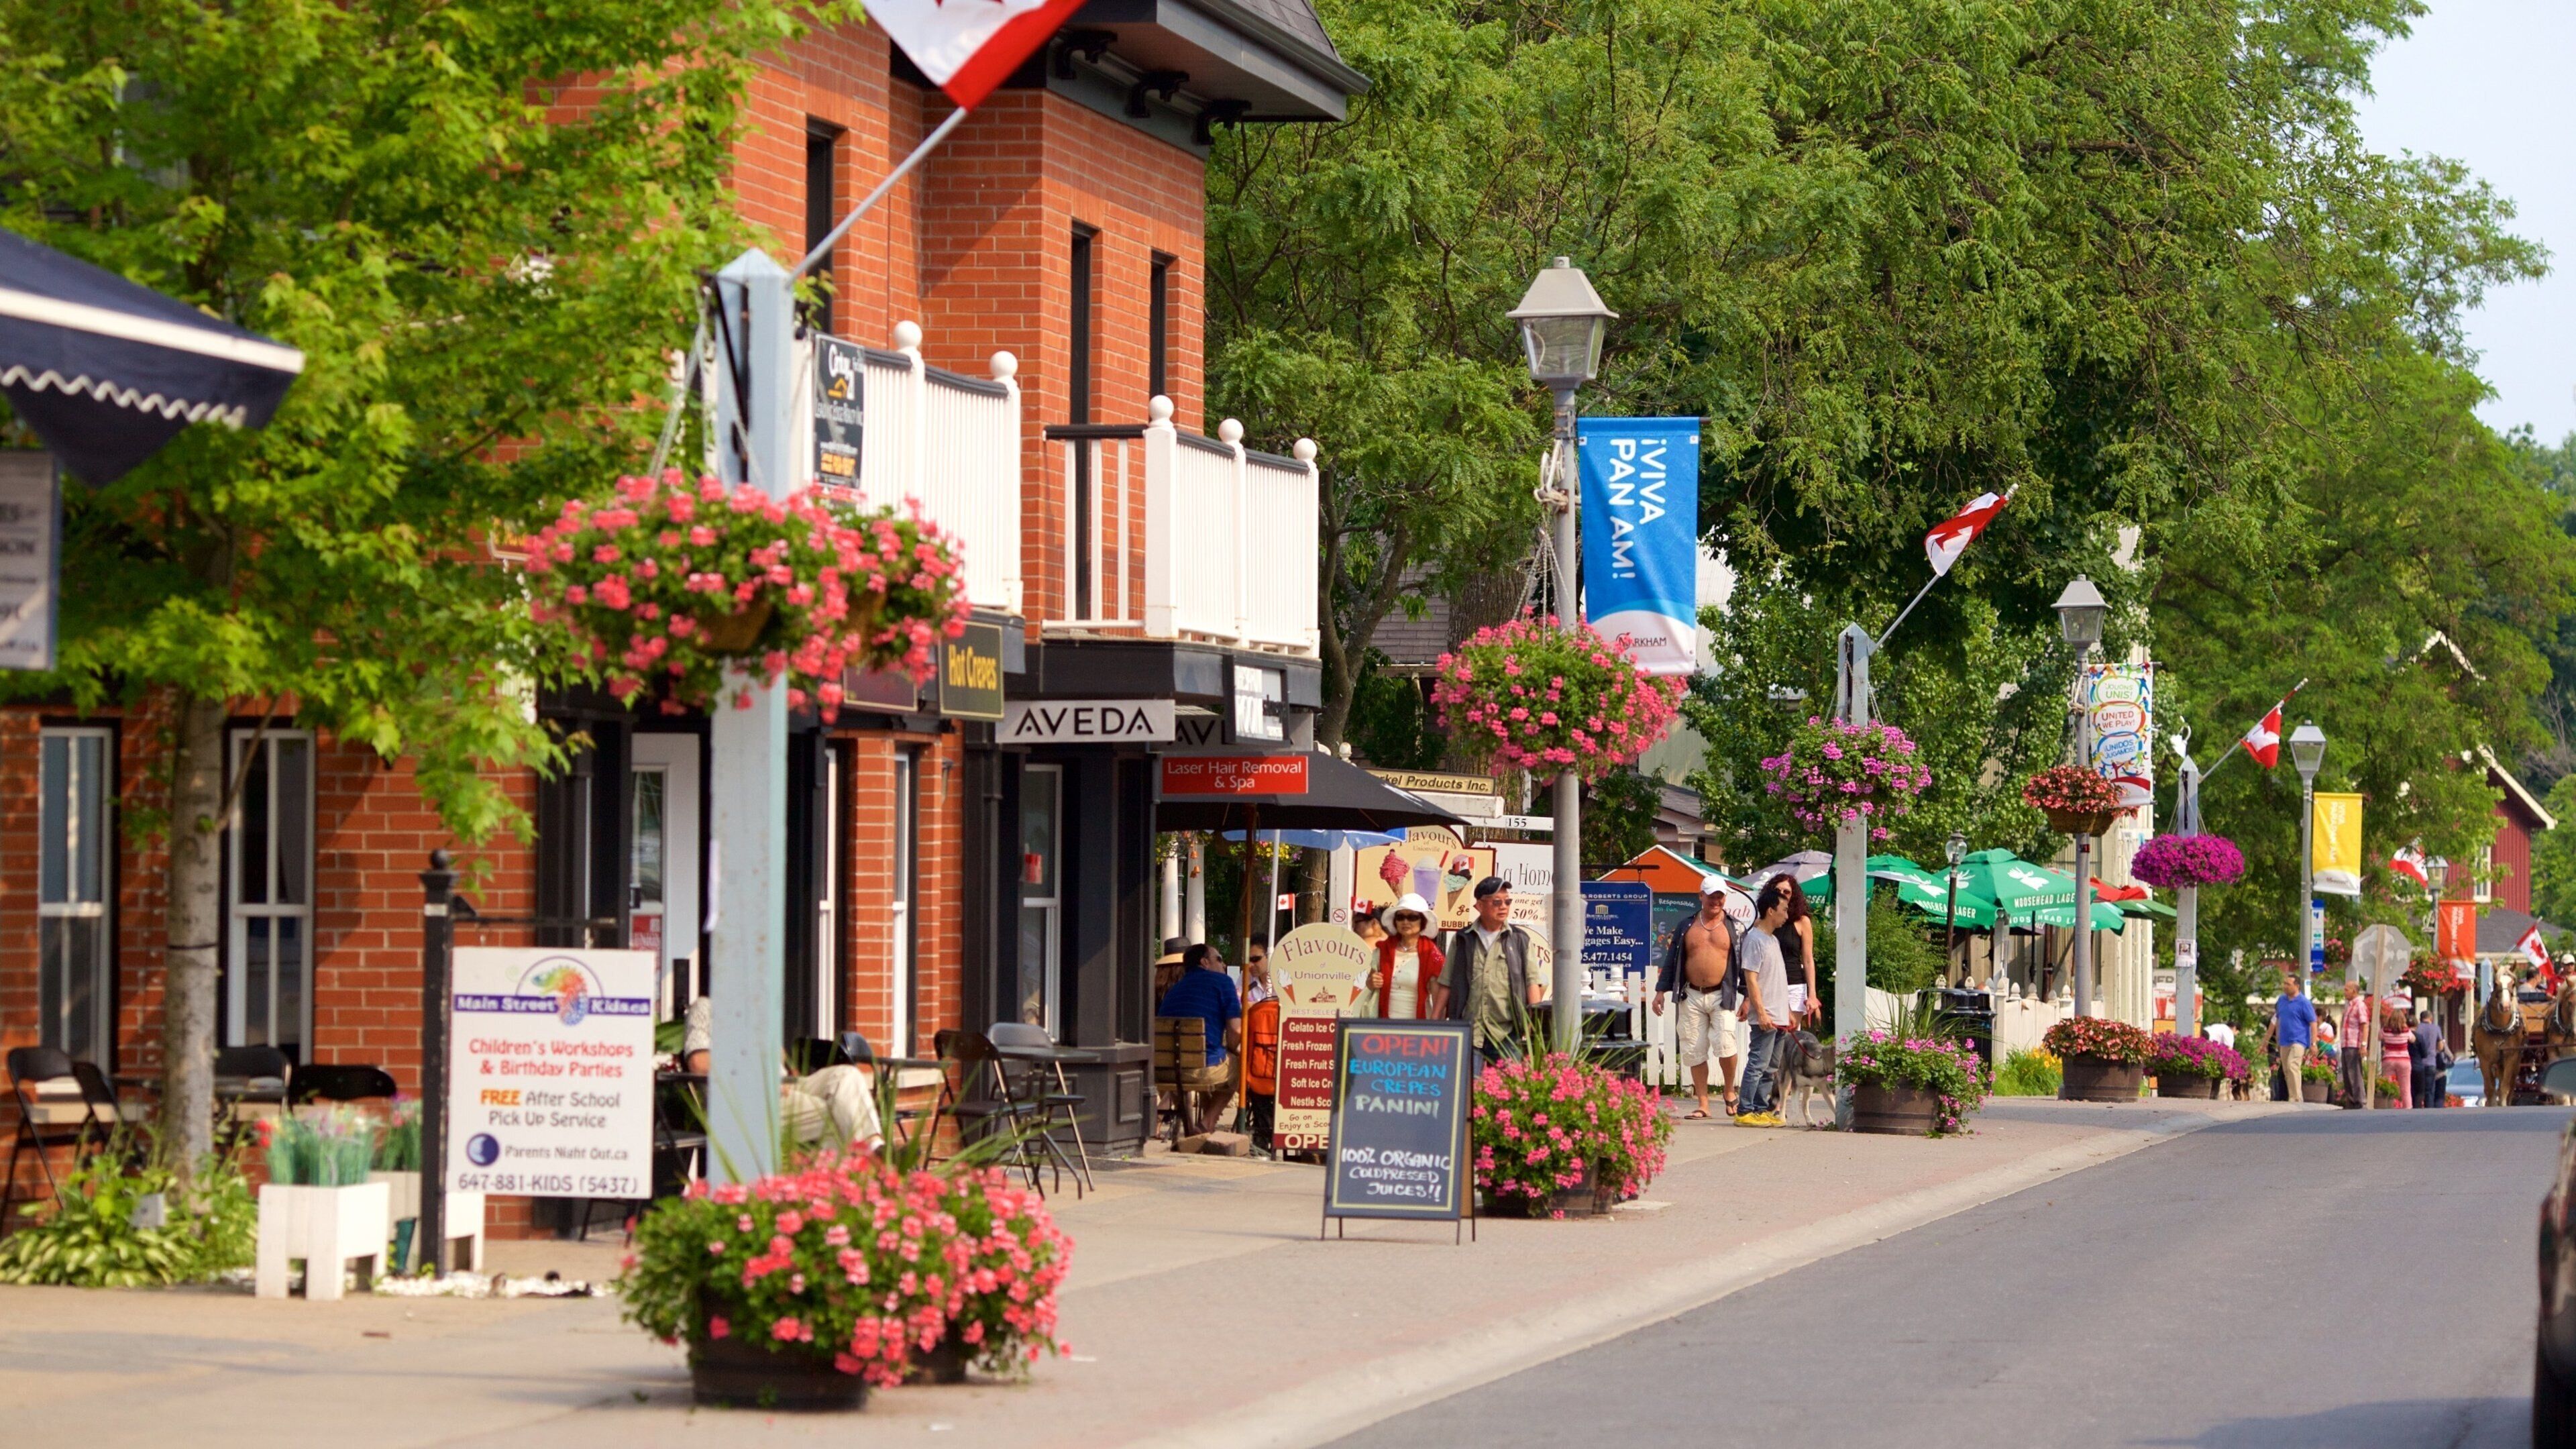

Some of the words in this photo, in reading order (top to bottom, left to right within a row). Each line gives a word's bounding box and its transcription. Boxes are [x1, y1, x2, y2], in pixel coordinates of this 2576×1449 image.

[1609, 438, 1636, 506] PAN
[1610, 516, 1636, 580] AM!
[948, 643, 966, 688] Hot
[967, 645, 997, 690] Crepes
[2106, 690, 2133, 699] UNIS!
[1014, 706, 1155, 736] AVEDA
[2101, 710, 2135, 720] UNITED
[2102, 721, 2114, 729] WE
[2115, 719, 2135, 728] PLAY!
[1168, 761, 1204, 774] Laser
[1208, 761, 1238, 774] Hair
[1242, 761, 1301, 774] Removal
[1214, 775, 1225, 788] &
[1230, 775, 1255, 792] Spa
[1406, 775, 1463, 790] Products
[1467, 780, 1489, 792] Inc.
[1507, 818, 1527, 828] 155
[1399, 830, 1457, 850] lavours
[1518, 863, 1554, 886] Hom
[2014, 894, 2053, 908] MOOSEHEAD
[2056, 892, 2076, 904] LAGE
[1511, 908, 1538, 920] 50%
[1954, 905, 1976, 919] LAGER
[1597, 926, 1623, 935] Make
[1585, 937, 1611, 947] gages
[1282, 937, 1366, 965] Flavours
[1294, 971, 1352, 981] Unionville
[458, 997, 498, 1010] Main
[502, 998, 555, 1012] Street
[1312, 1008, 1354, 1016] SELECION
[1289, 1022, 1315, 1032] Gelato
[1316, 1022, 1328, 1033] Ice
[470, 1038, 545, 1055] Children's
[550, 1040, 633, 1058] Workshops
[1282, 1040, 1304, 1051] Fresh
[1305, 1040, 1332, 1051] Frozen
[1362, 1034, 1450, 1059] OPEN!
[480, 1059, 493, 1075] &
[500, 1060, 563, 1077] Birthday
[570, 1061, 623, 1077] Parties
[1285, 1059, 1307, 1069] Fresh
[1309, 1059, 1328, 1070] Fruit
[1349, 1058, 1447, 1079] EUROPEAN
[1291, 1077, 1307, 1087] Soft
[1308, 1078, 1320, 1088] Ice
[1371, 1078, 1442, 1097] CREPES
[480, 1089, 521, 1106] FREE
[525, 1091, 565, 1106] After
[570, 1091, 621, 1108] School
[1290, 1096, 1315, 1107] Nestle
[1316, 1096, 1332, 1107] Sco
[1354, 1093, 1440, 1120] PANINI
[488, 1111, 521, 1126] Pick
[525, 1112, 545, 1126] Up
[549, 1112, 606, 1128] Service
[1279, 1122, 1301, 1131] Enjoy
[1284, 1134, 1330, 1149] OPE
[504, 1144, 550, 1159] Parents
[553, 1146, 586, 1161] Night
[1341, 1146, 1376, 1165] 100%
[1380, 1150, 1451, 1171] ORGANIC
[1349, 1166, 1440, 1183] COLDPRESSED
[458, 1173, 572, 1191] 647-881-KIDS
[579, 1176, 638, 1194] (5437)
